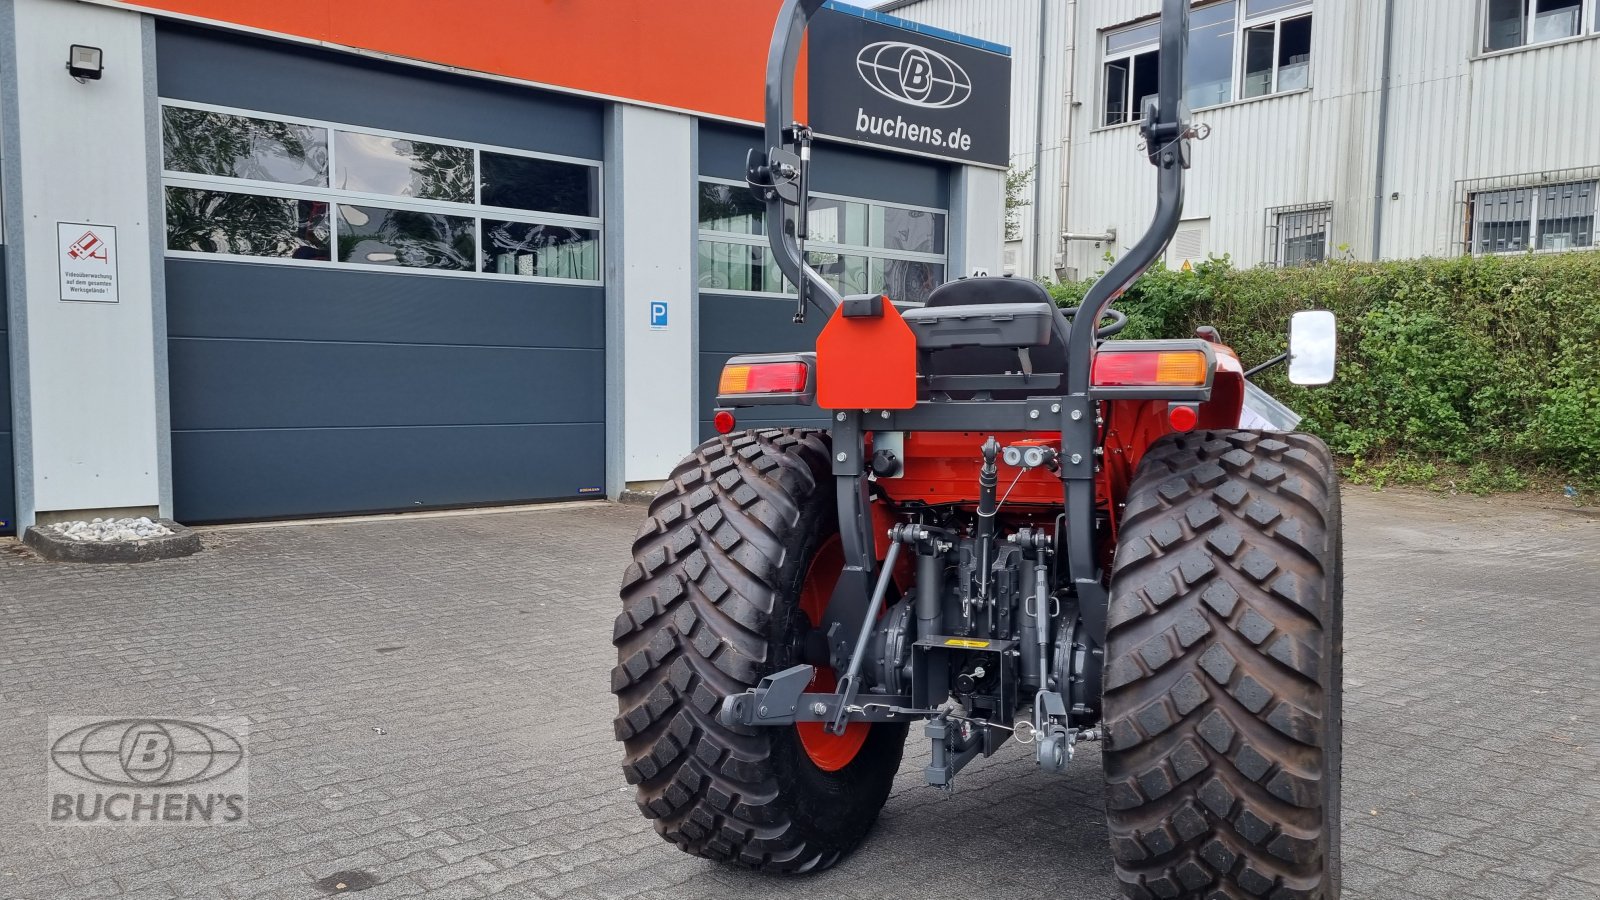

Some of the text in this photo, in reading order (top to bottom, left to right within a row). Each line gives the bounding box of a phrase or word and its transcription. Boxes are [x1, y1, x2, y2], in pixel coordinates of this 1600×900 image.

[902, 55, 930, 93] B
[856, 107, 972, 151] buchens.de
[65, 271, 112, 280] Videoüberwachung
[70, 286, 105, 294] Werksgelände
[653, 304, 666, 323] P
